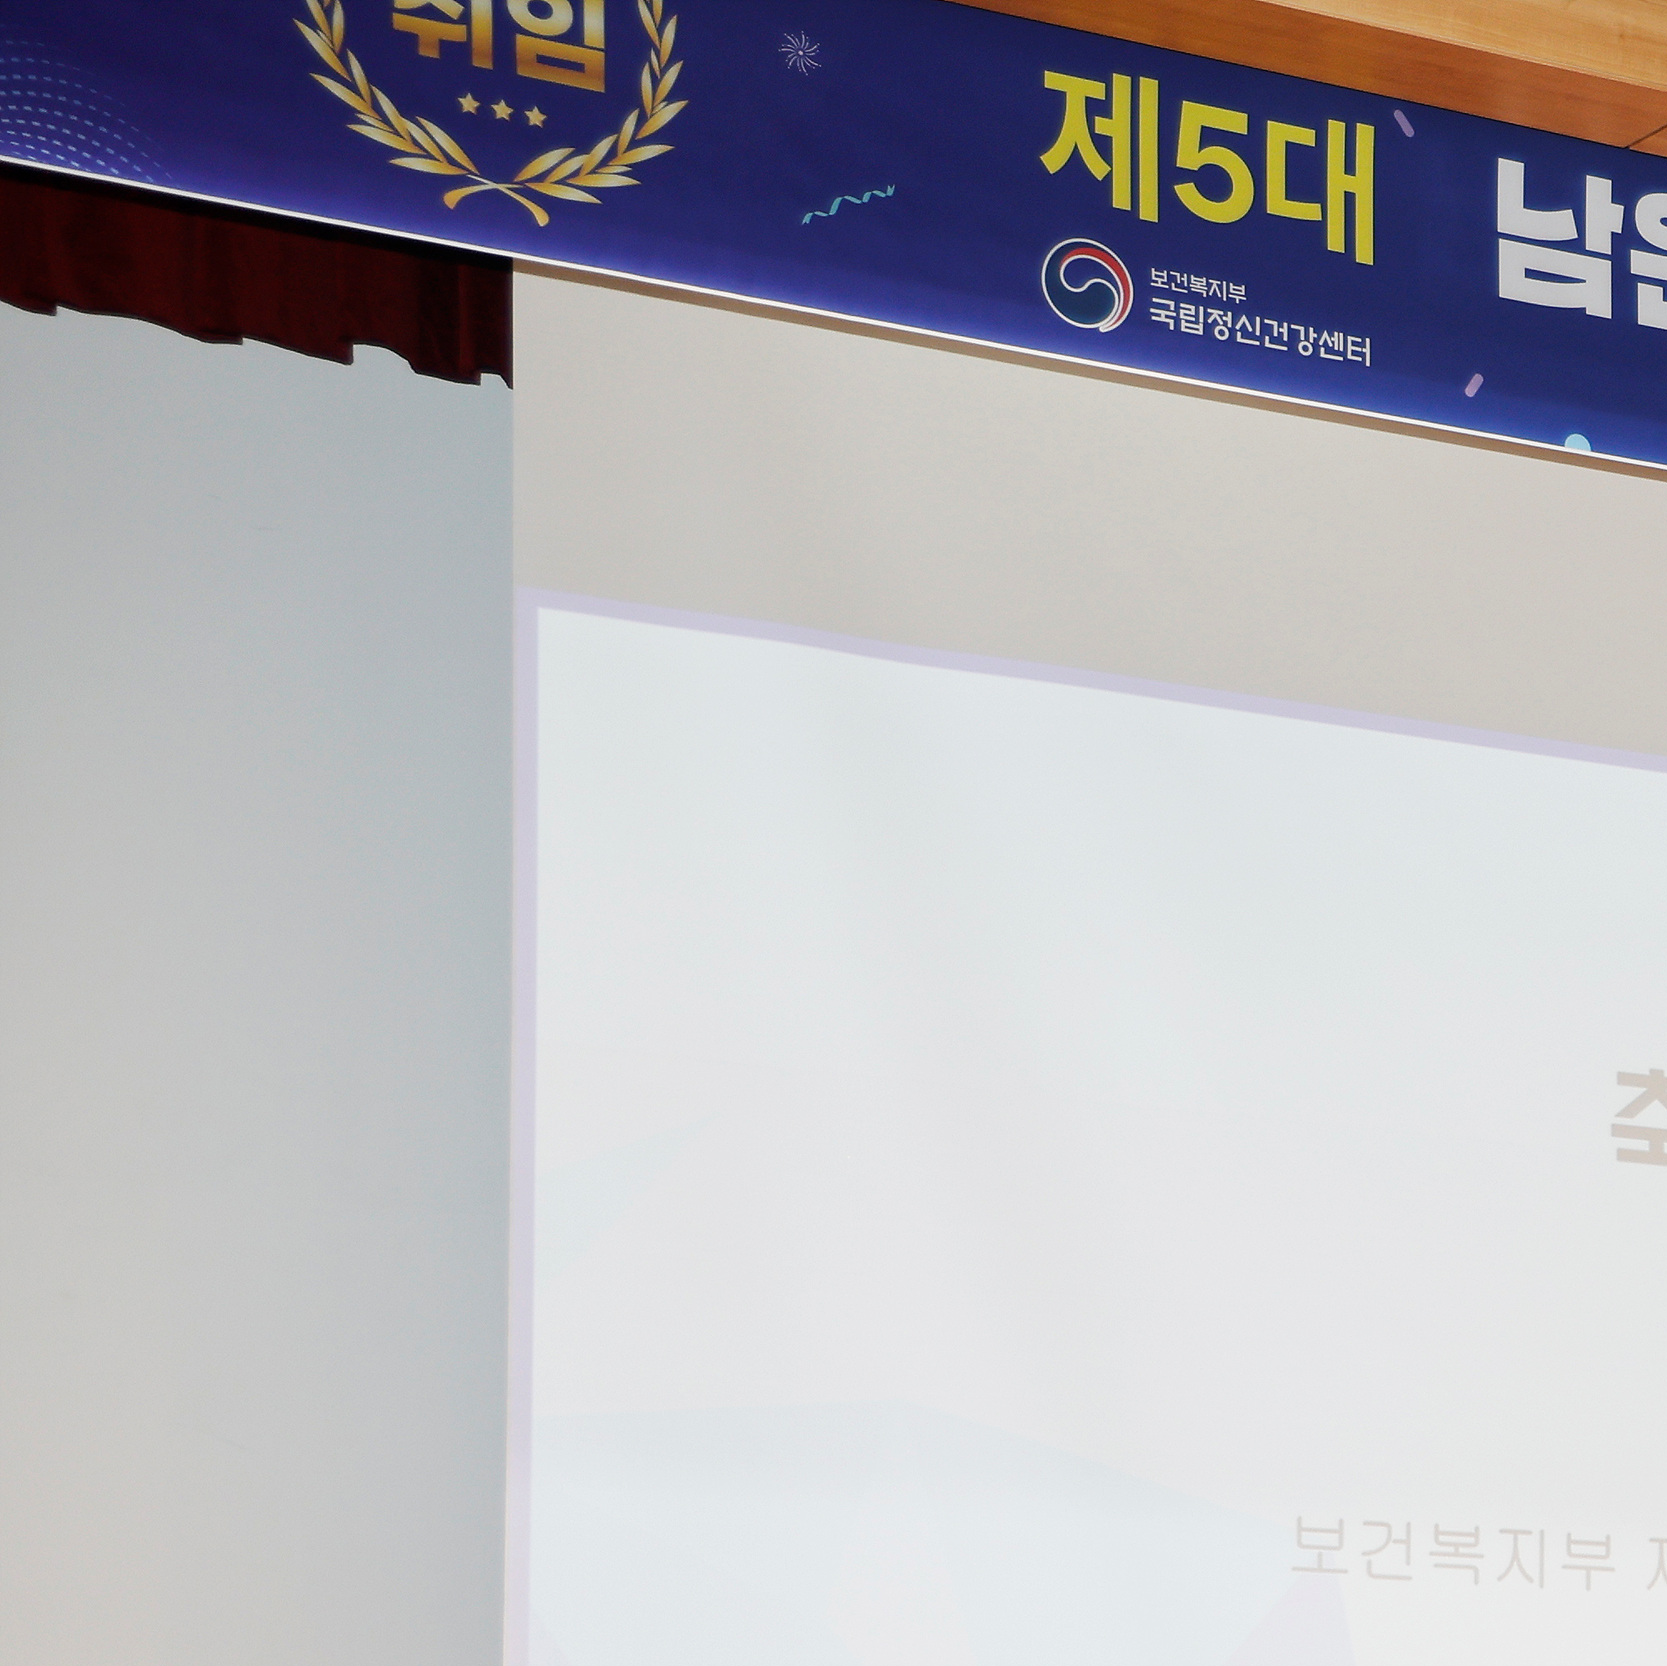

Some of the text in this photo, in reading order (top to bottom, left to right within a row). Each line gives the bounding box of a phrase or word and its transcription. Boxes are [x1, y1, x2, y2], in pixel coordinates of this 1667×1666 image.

[392, 0, 605, 93] 취임
[1040, 70, 1376, 266] 제5대
[1149, 266, 1247, 304] 보건복지부
[1149, 298, 1373, 368] 국립정신건강센터
[1290, 1514, 1617, 1594] 보건복지부
